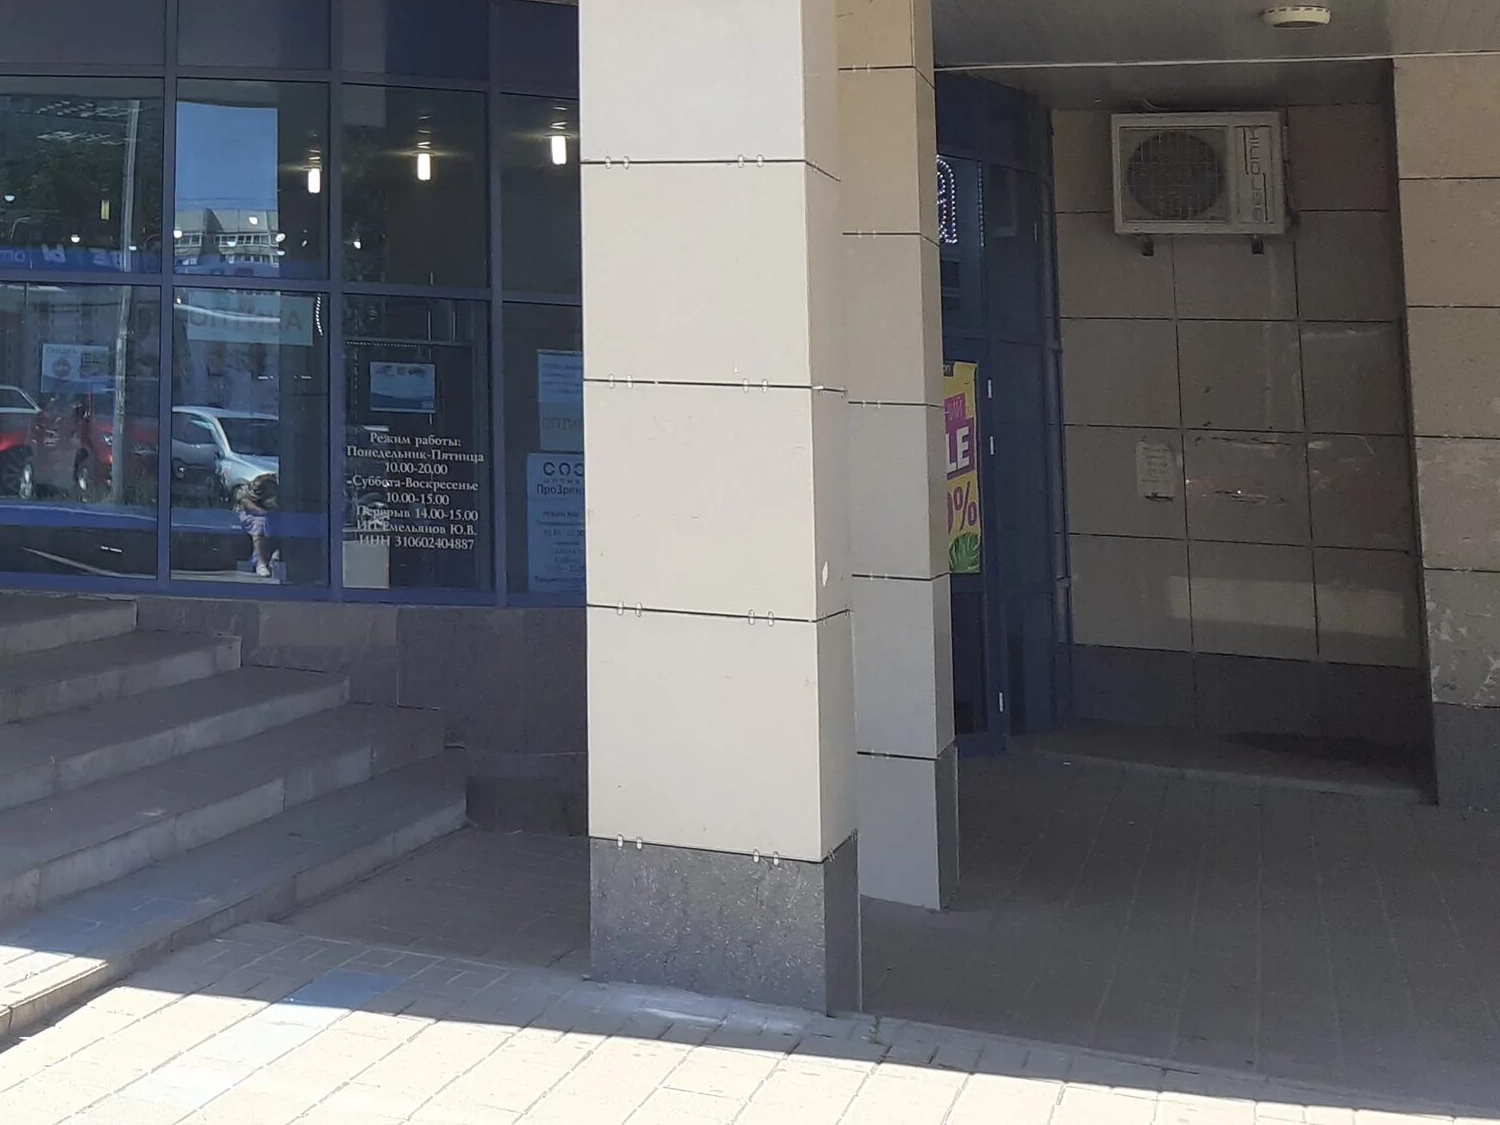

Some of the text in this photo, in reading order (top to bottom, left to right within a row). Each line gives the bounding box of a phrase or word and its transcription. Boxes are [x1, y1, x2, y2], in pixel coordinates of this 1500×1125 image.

[370, 432, 461, 447] Режим работы:
[347, 445, 484, 463] Понедельник-Пятница
[385, 462, 448, 475] 10.00-20.00
[353, 475, 479, 492] Суббота-Воскресенье
[386, 492, 450, 505] 10.00-15.00
[415, 508, 478, 521] 14.00-15.00
[383, 522, 446, 534] Емельянов
[450, 524, 477, 536] Ю.В.
[359, 534, 475, 550] ИНН 310602404887
